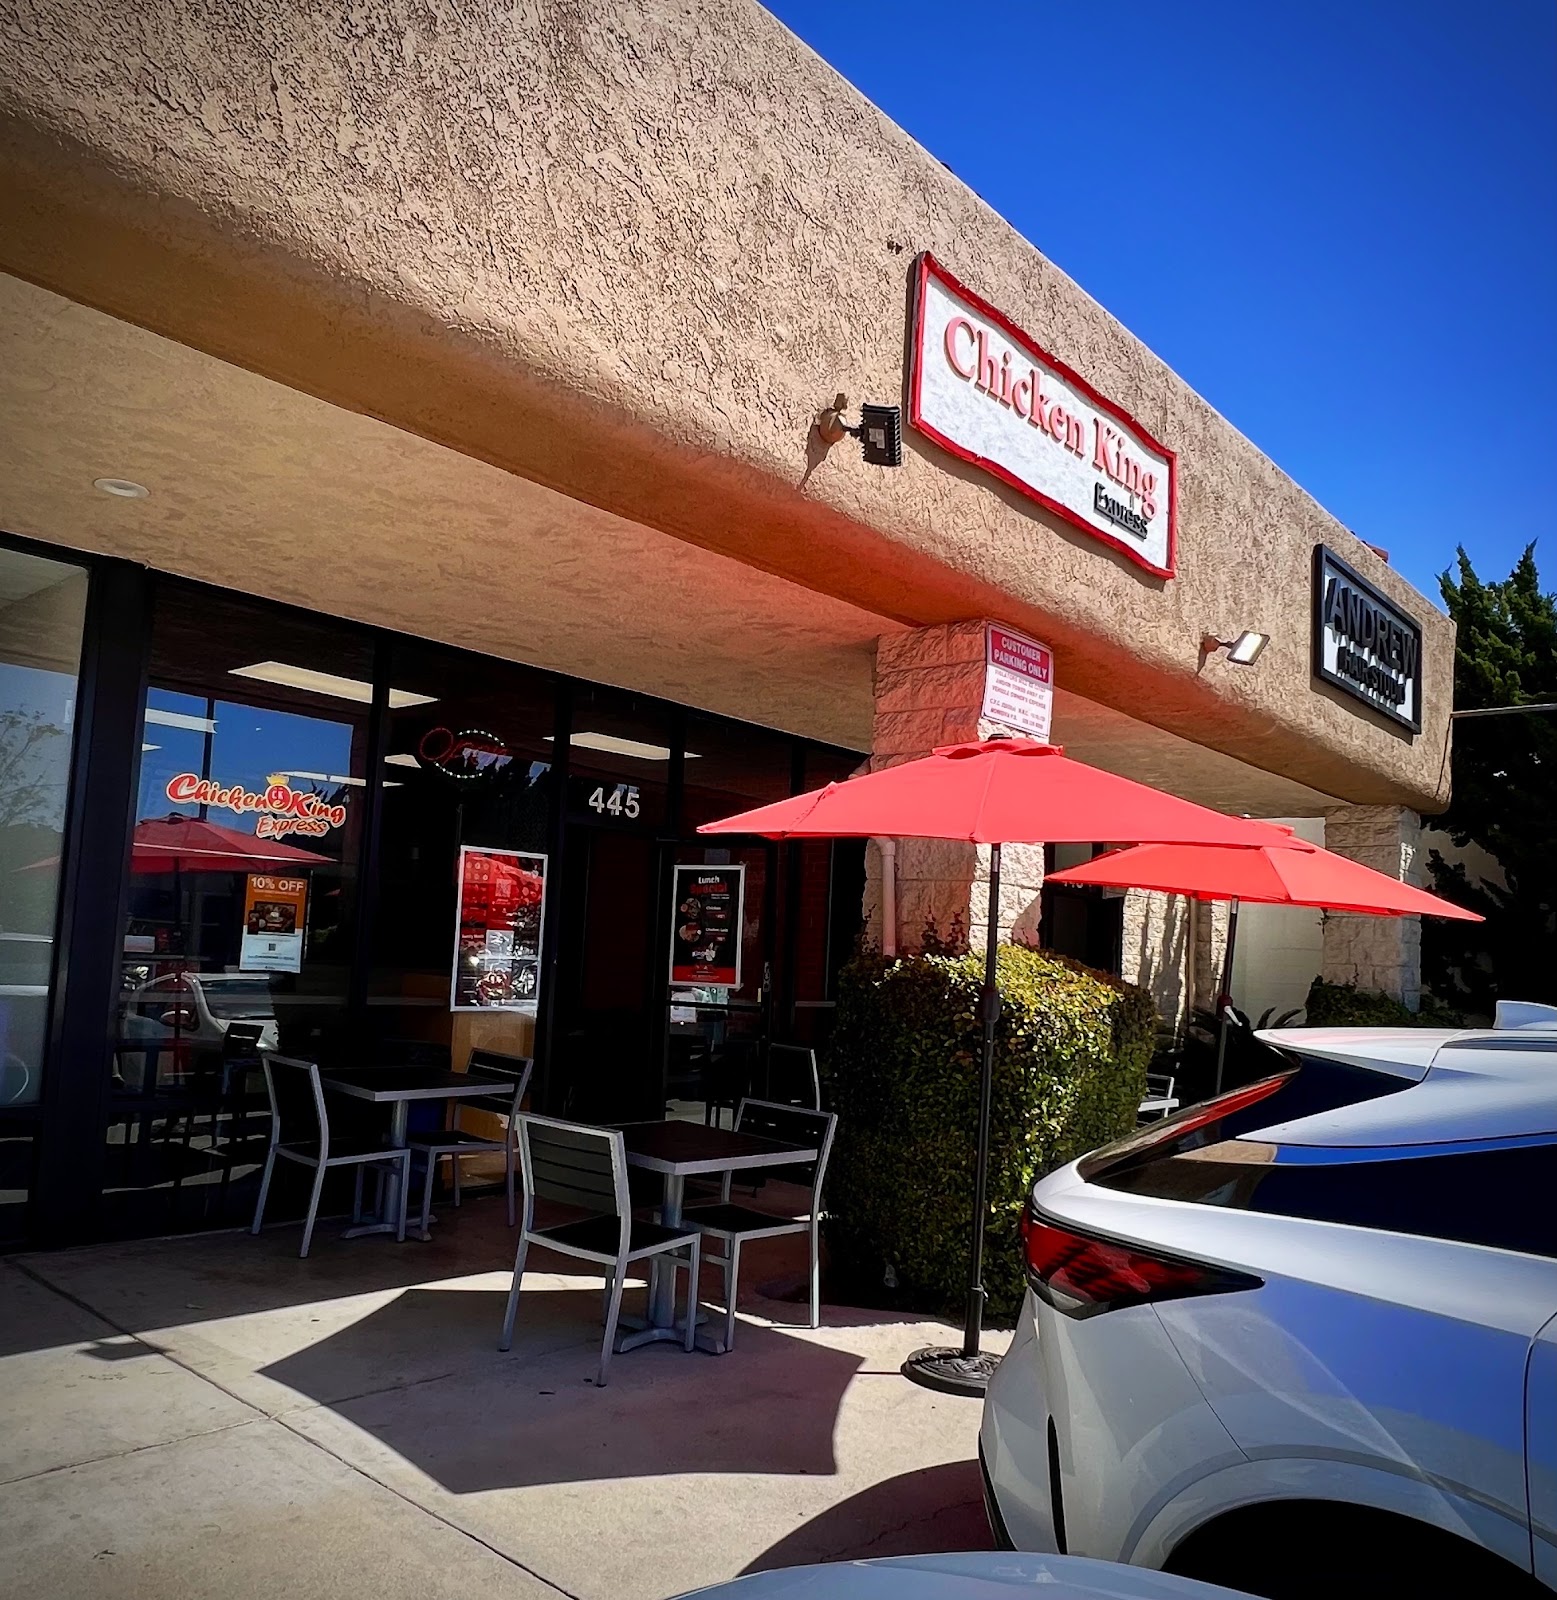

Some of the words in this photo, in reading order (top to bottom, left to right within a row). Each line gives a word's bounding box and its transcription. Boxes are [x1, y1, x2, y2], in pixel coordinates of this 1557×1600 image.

[943, 316, 1085, 459] Chicken
[1093, 418, 1158, 520] King
[1095, 482, 1148, 540] Express
[1325, 578, 1418, 679] ANDREW
[993, 648, 1027, 672] PARKING
[1028, 662, 1048, 680] ONLY
[1001, 636, 1041, 663] CUSTOMER
[167, 774, 268, 812] Chicken
[288, 790, 345, 826] King
[588, 787, 640, 818] 445
[257, 817, 328, 838] Express
[251, 876, 276, 890] 10%
[278, 880, 304, 892] OFF
[698, 875, 720, 885] Lunch
